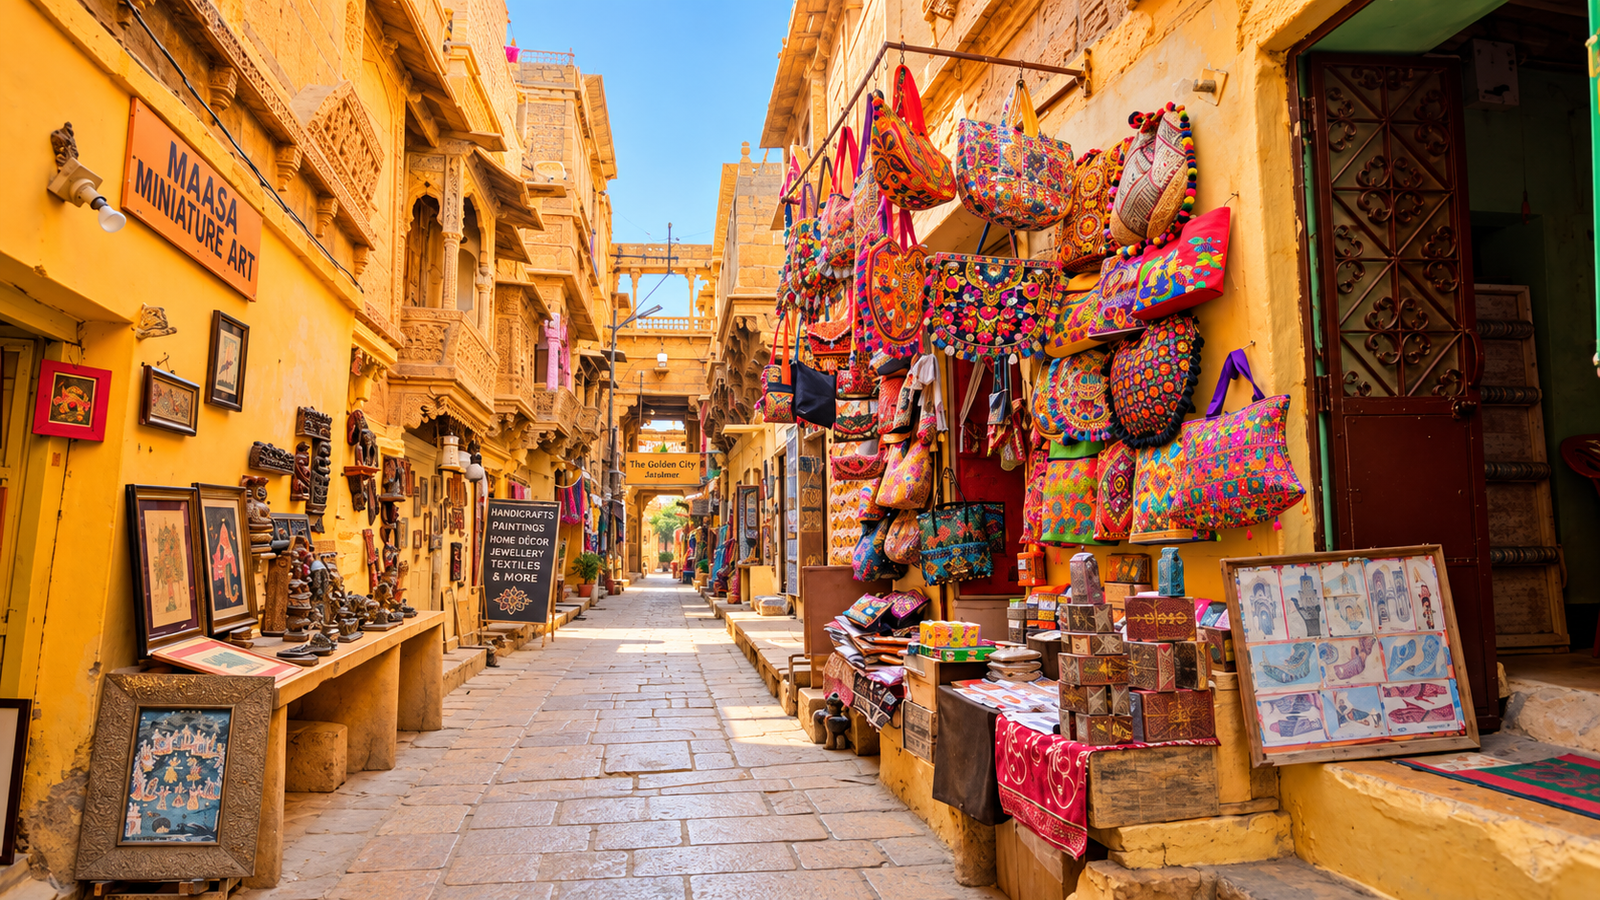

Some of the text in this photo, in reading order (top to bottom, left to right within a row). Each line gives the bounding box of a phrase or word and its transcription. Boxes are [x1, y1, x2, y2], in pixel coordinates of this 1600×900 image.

[167, 140, 237, 235] MAASA
[135, 159, 255, 282] MINIATURE ART
[630, 460, 696, 470] The Golden City
[491, 508, 554, 519] HANDICRAFTS
[492, 521, 545, 532] PAINTINGS
[490, 535, 515, 544] HOME
[490, 548, 544, 557] JEWELLERY
[491, 559, 540, 570] TEXTILES
[492, 572, 538, 582] & MORE
